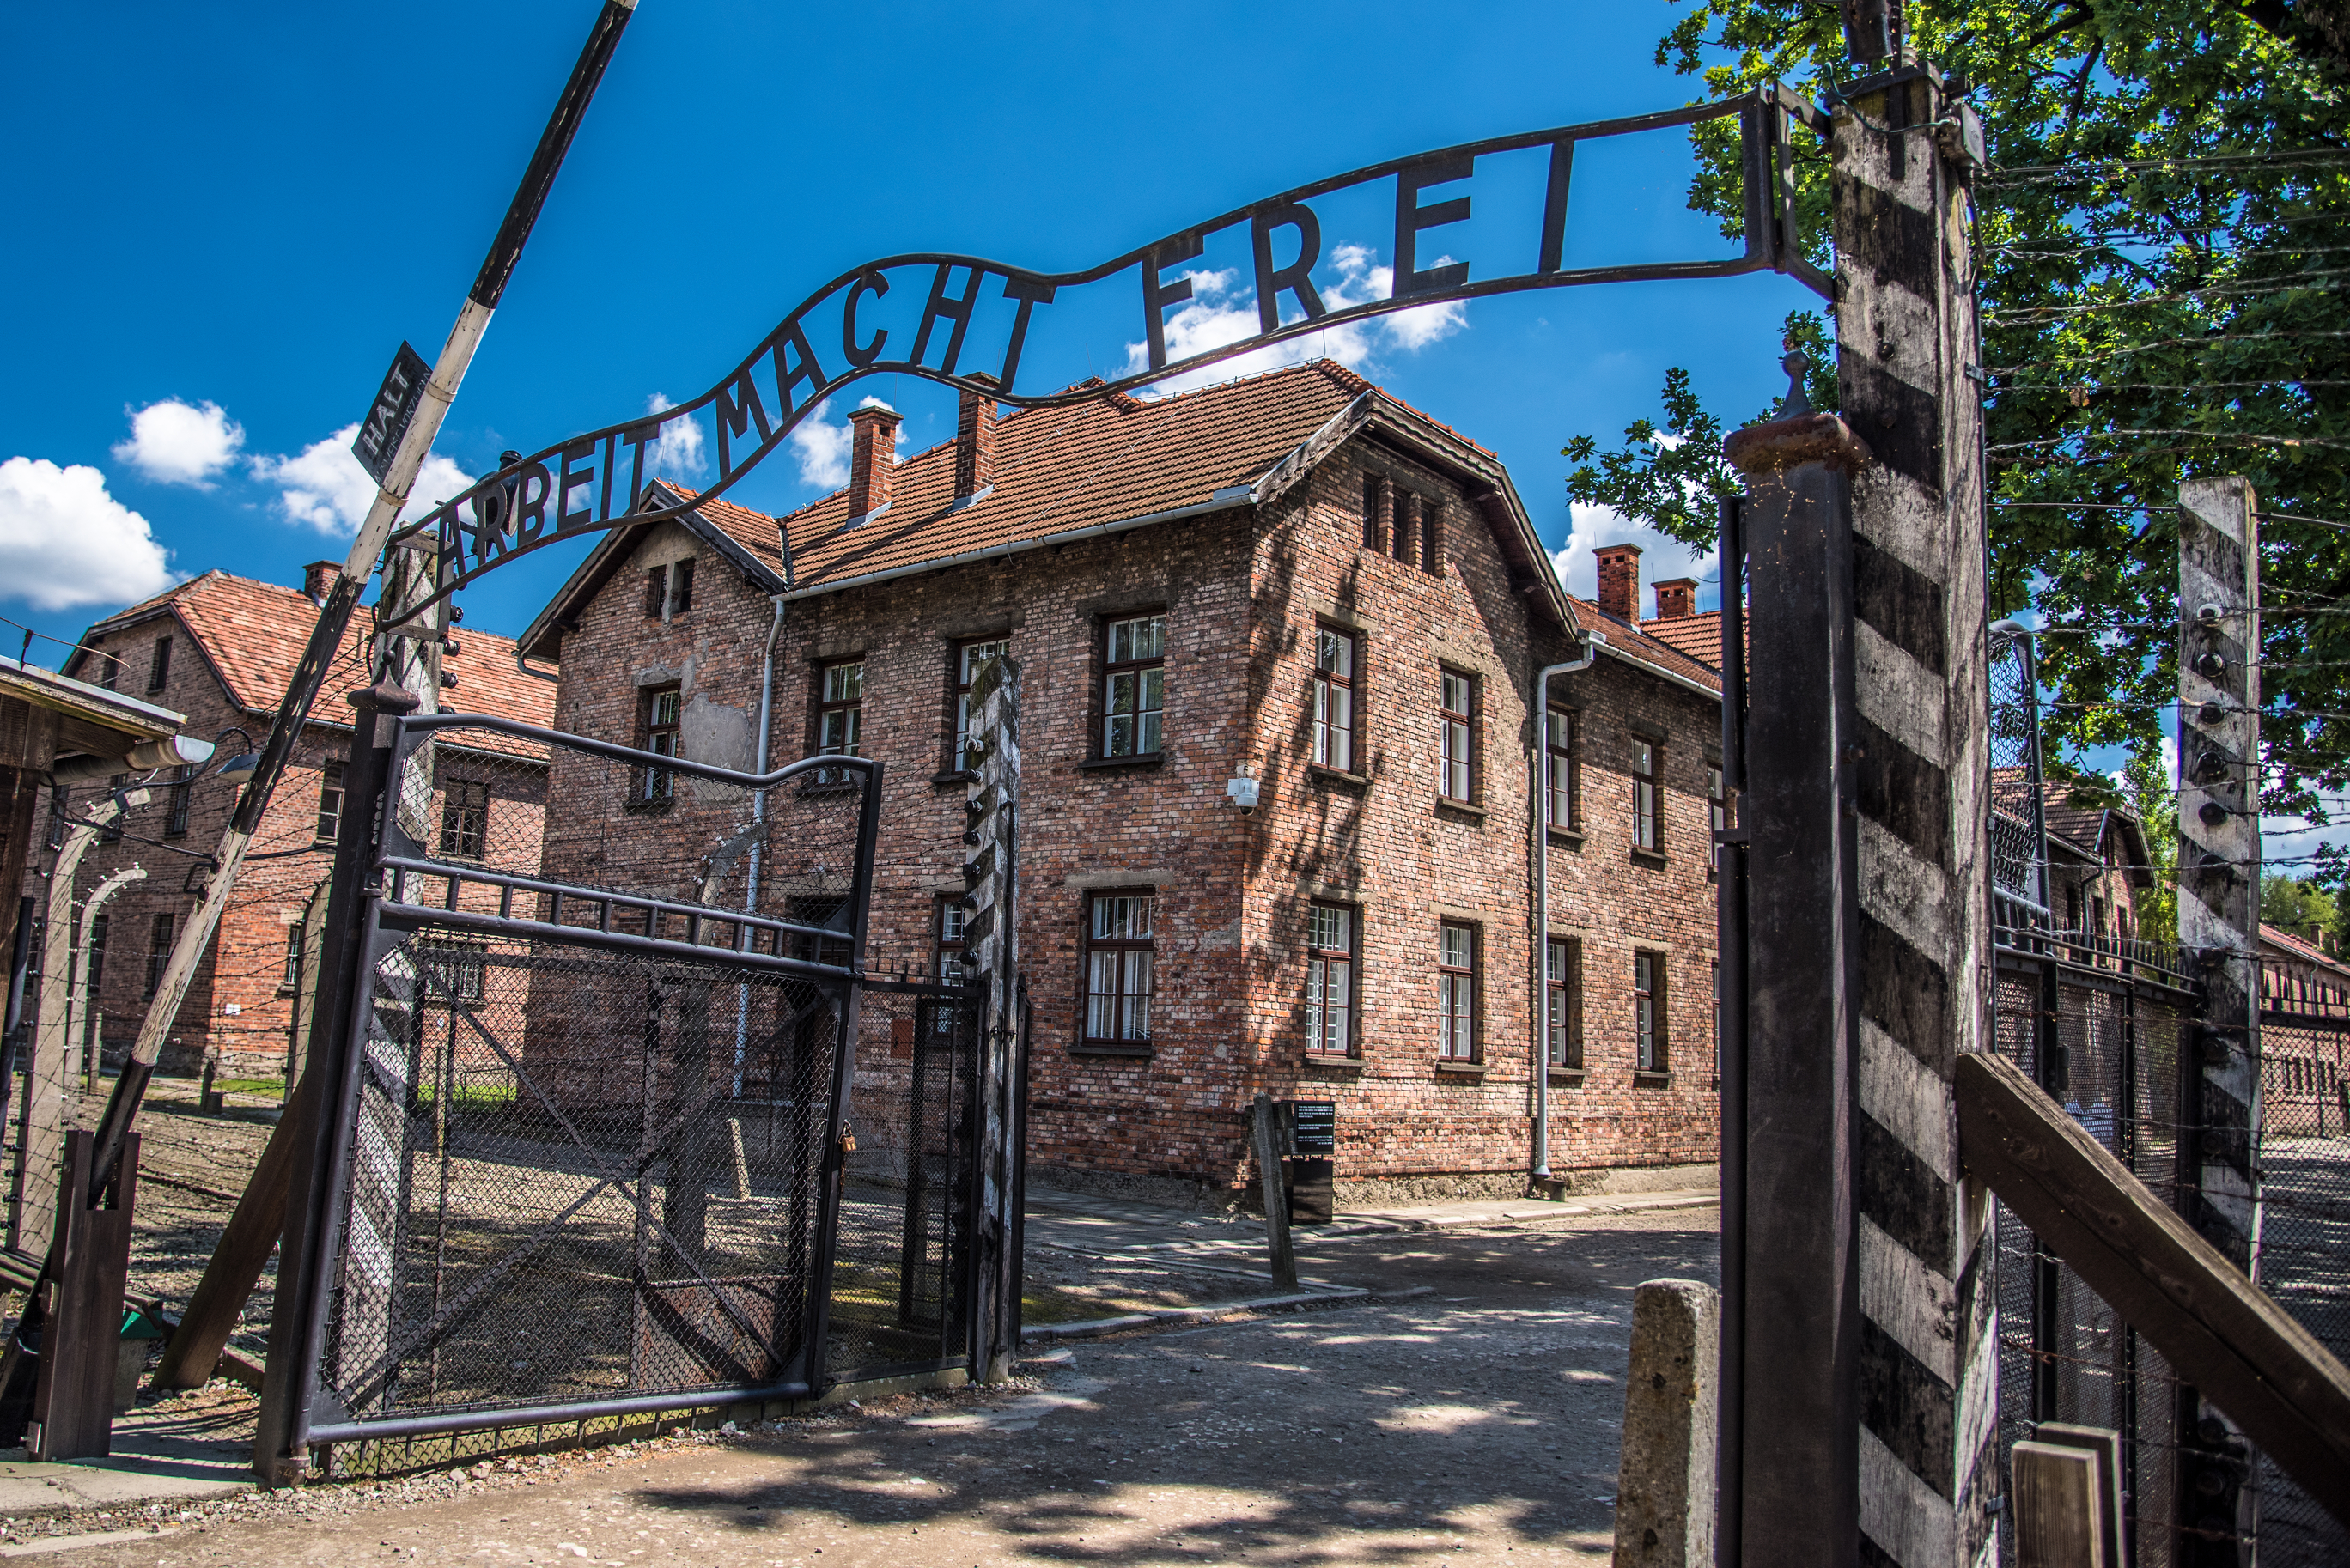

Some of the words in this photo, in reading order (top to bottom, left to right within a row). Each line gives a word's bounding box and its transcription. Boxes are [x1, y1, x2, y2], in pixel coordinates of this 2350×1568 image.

[362, 362, 409, 455] HALT
[435, 422, 661, 593] ARBEIT
[715, 264, 1056, 479] MACHT
[1141, 139, 1574, 369] FREI
